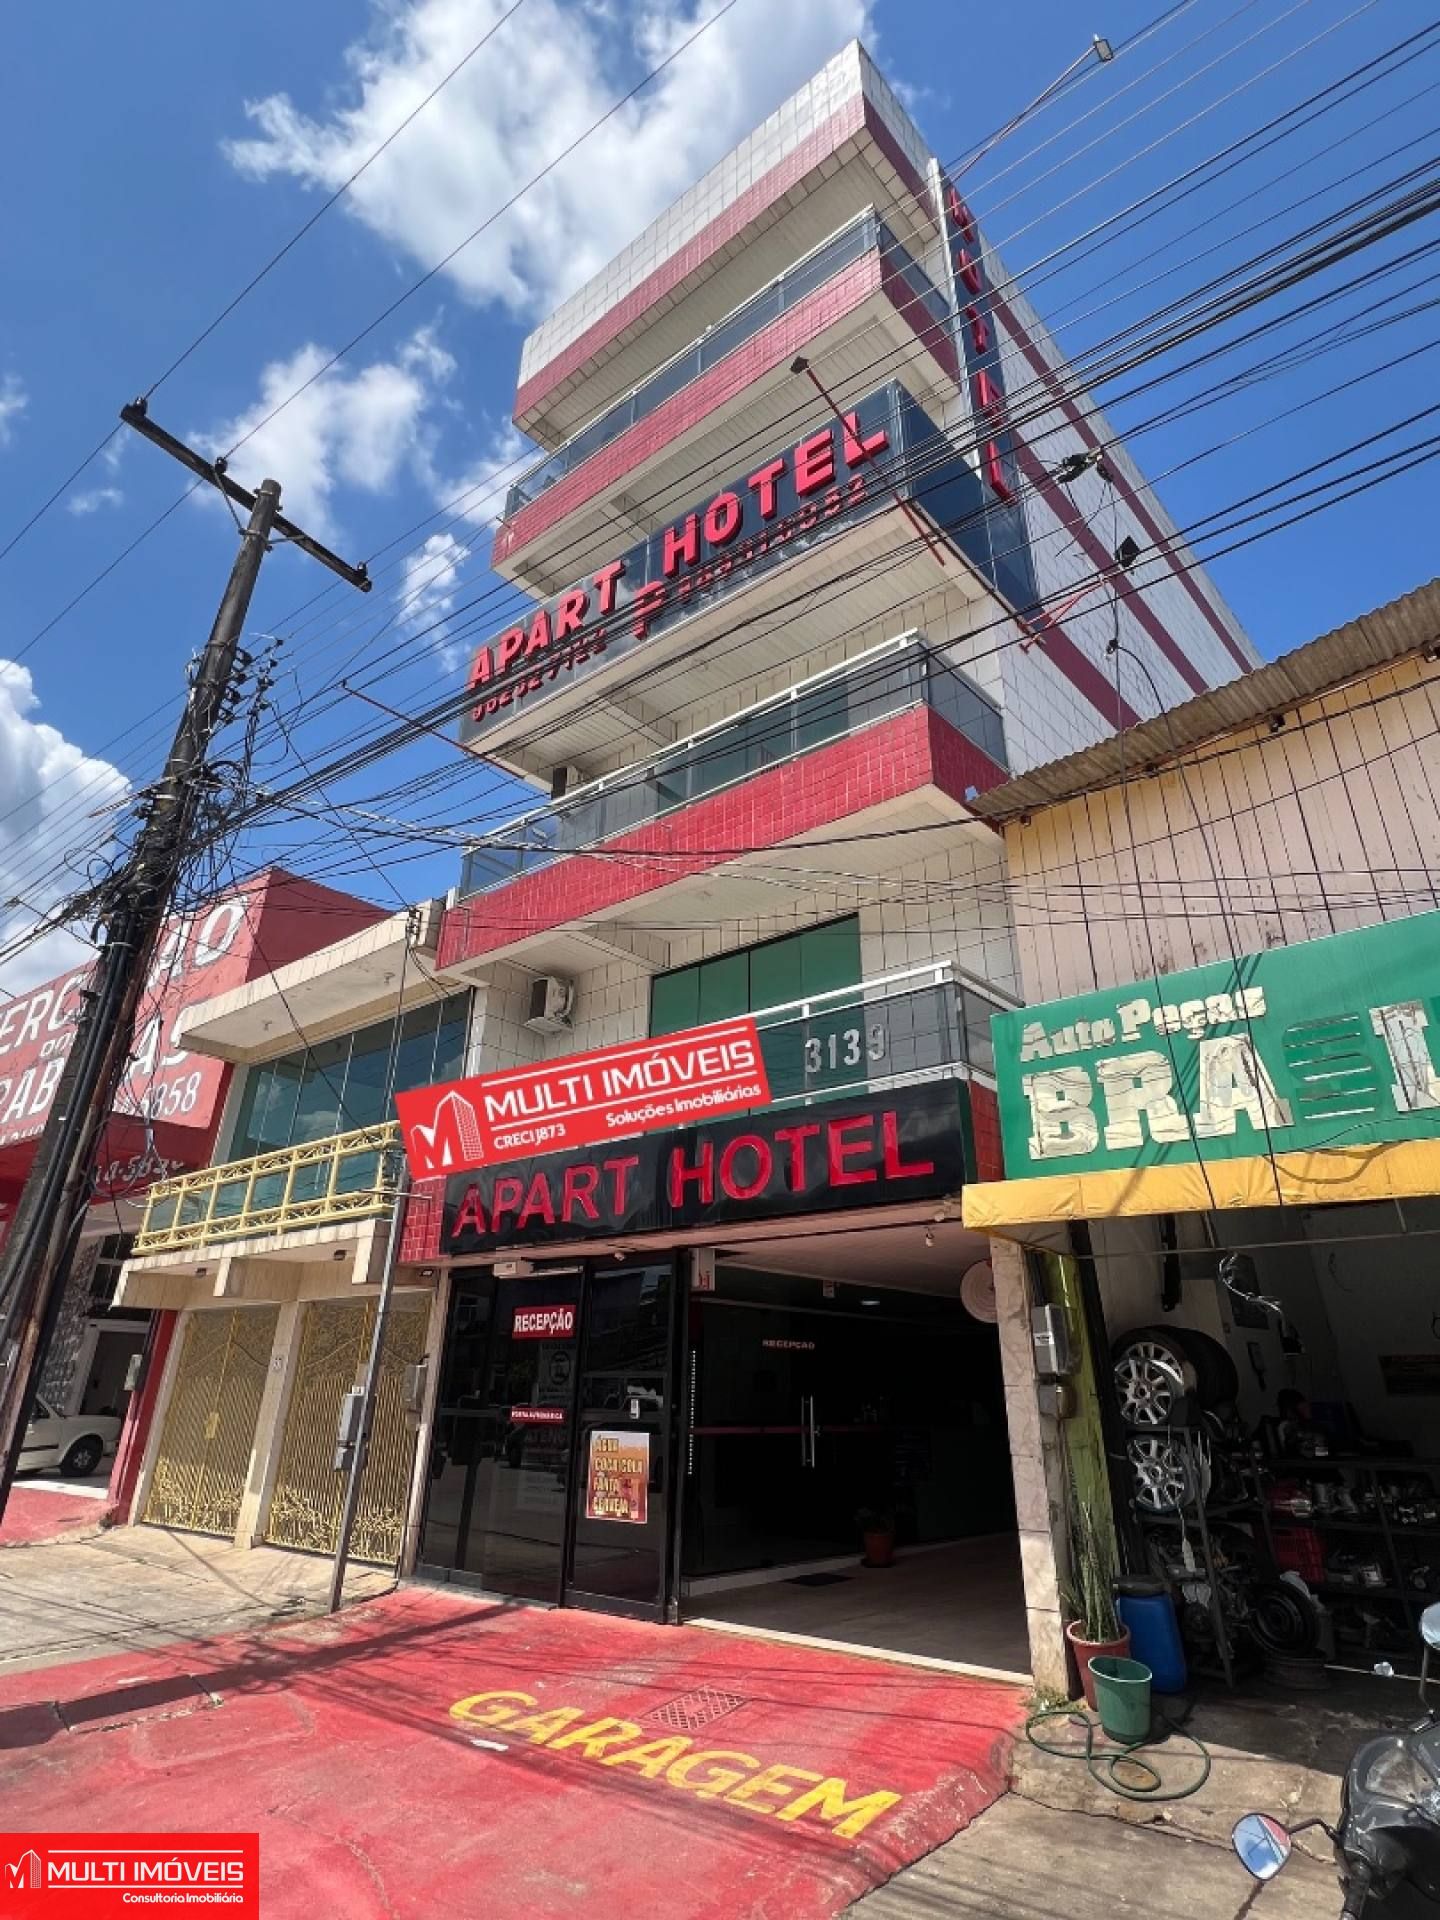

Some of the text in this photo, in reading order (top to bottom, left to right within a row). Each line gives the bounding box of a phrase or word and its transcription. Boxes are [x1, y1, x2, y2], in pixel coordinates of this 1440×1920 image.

[948, 185, 1020, 507] HOTEL
[467, 559, 626, 692] APART
[663, 411, 889, 577] HOTEL
[804, 1023, 887, 1073] 3139
[1020, 1017, 1116, 1062] Auto
[453, 1109, 935, 1238] APART HOTEL
[448, 1690, 903, 1839] GARAGEM
